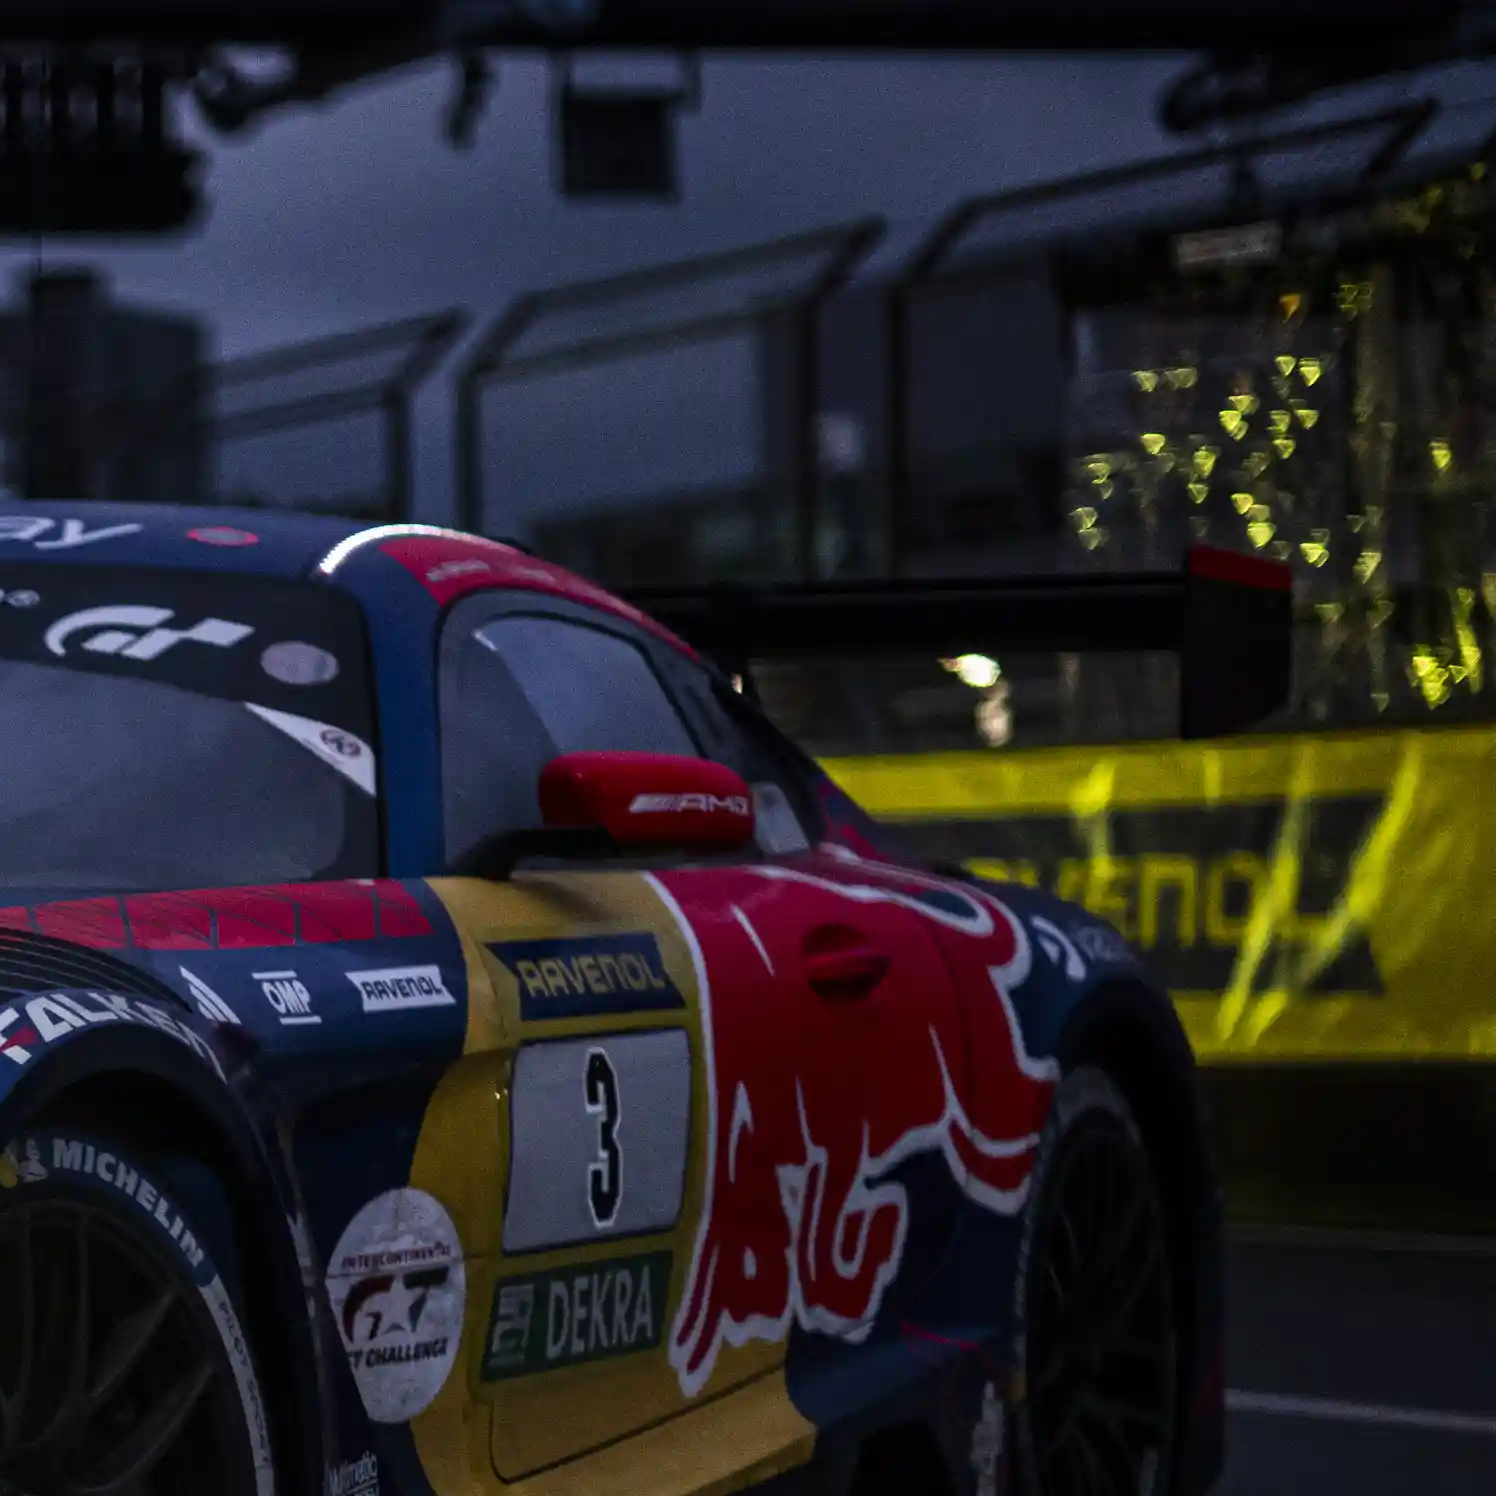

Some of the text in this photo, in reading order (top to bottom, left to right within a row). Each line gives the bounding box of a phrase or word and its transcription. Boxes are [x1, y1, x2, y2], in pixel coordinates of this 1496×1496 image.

[258, 976, 314, 1017] OMP
[360, 975, 443, 1001] RAVENOL
[517, 947, 666, 998] RAVENOL
[584, 1046, 624, 1229] 3
[51, 1137, 204, 1268] MICHELIN
[545, 1264, 654, 1361] DEKRA
[365, 1337, 449, 1368] CHALLENGE
